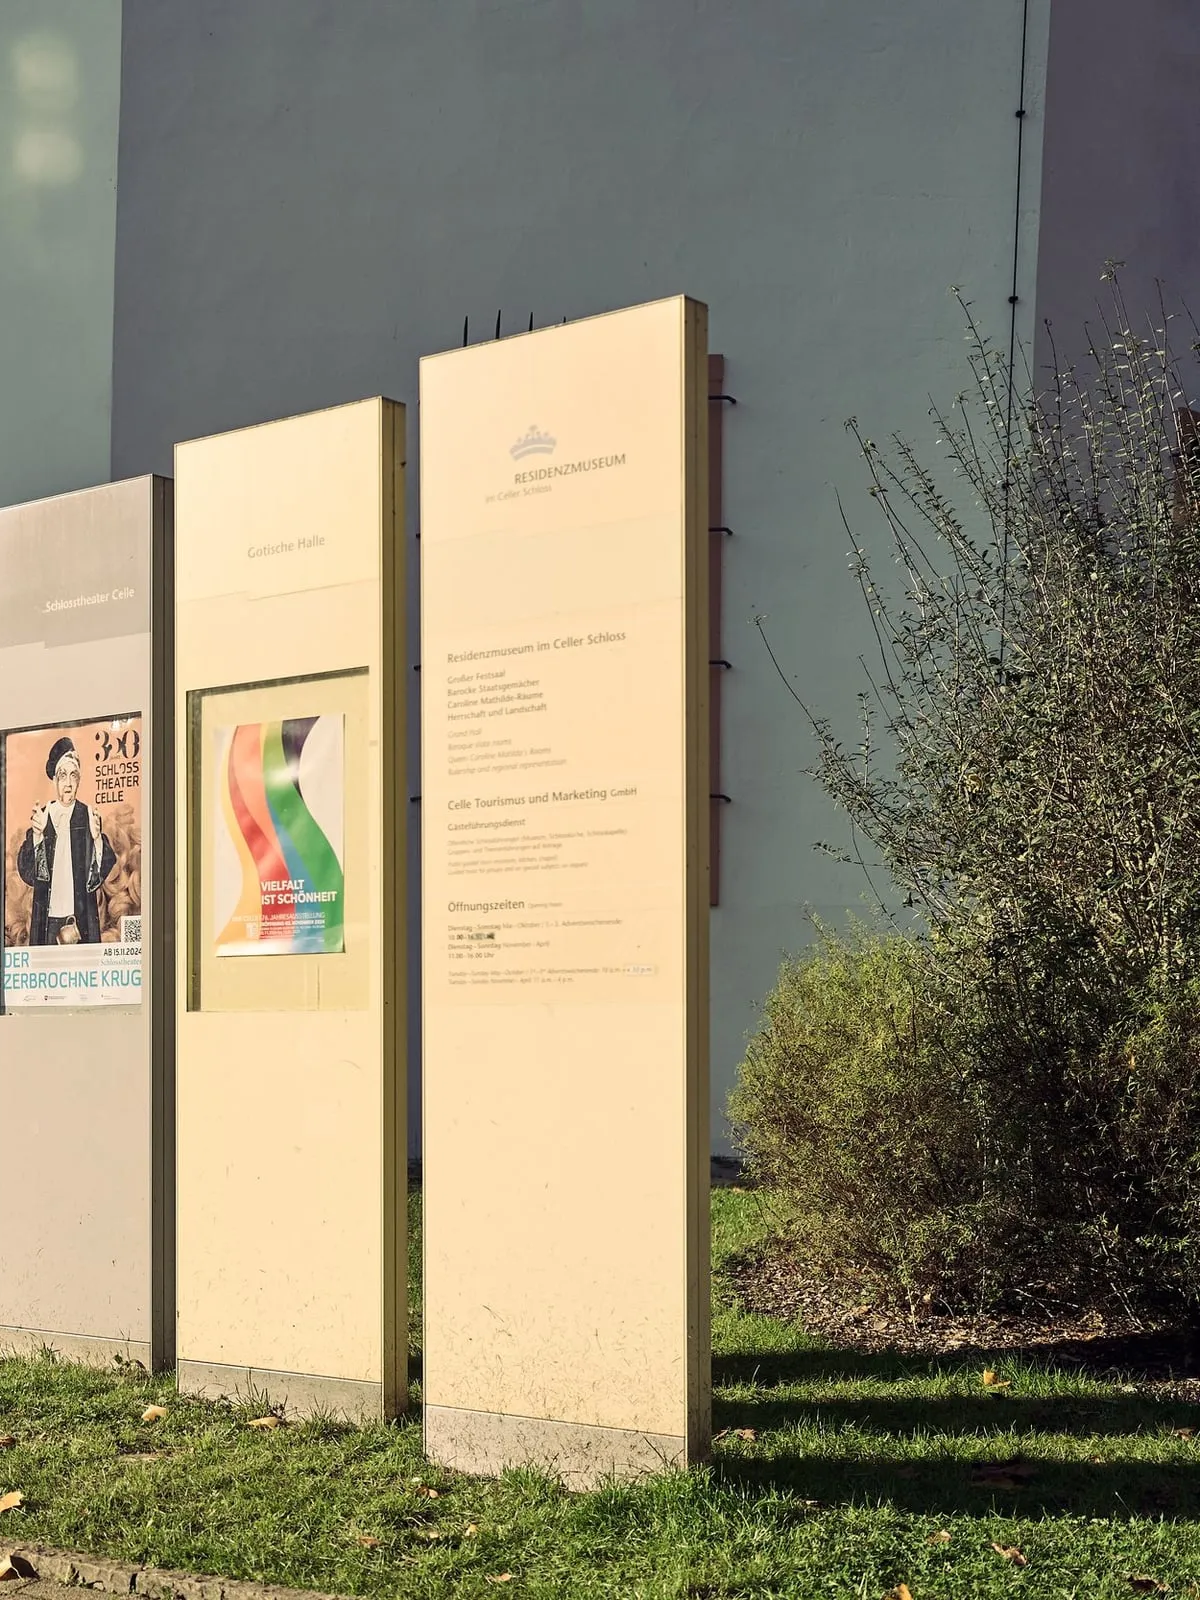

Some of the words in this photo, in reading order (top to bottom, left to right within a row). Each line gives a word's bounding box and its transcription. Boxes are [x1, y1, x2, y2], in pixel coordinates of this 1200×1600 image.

[514, 453, 626, 485] RESIDENZMUSEUM
[497, 489, 520, 501] Celler
[523, 484, 552, 497] Schloss
[247, 541, 295, 558] Gotische
[297, 535, 326, 549] Halle
[45, 592, 111, 612] Schlosstheater
[112, 587, 135, 600] Celle
[447, 644, 534, 663] Residenzmuseum
[537, 640, 551, 652] im
[553, 636, 584, 650] Celler
[587, 631, 627, 645] Schloss
[476, 669, 506, 681] Festsaal
[447, 686, 476, 697] Barocke
[447, 698, 479, 709] Caroline
[447, 710, 486, 721] Herrschaft
[488, 708, 504, 717] und
[505, 703, 547, 715] Landschaft
[95, 775, 140, 790] THEATER
[95, 790, 124, 804] CELLE
[447, 799, 472, 811] Celle
[474, 796, 526, 809] Tourismus
[528, 791, 549, 804] und
[552, 788, 608, 803] Marketing
[610, 787, 637, 798] GmbH
[261, 879, 305, 892] VIELFALT
[261, 894, 276, 905] IST
[277, 890, 338, 905] SCHÖNHEIT
[447, 900, 525, 914] Öffnungszeiten
[3, 952, 30, 969] DER
[103, 948, 113, 957] AB
[3, 970, 99, 990] ZERBROCHNE
[101, 969, 142, 988] KRUG
